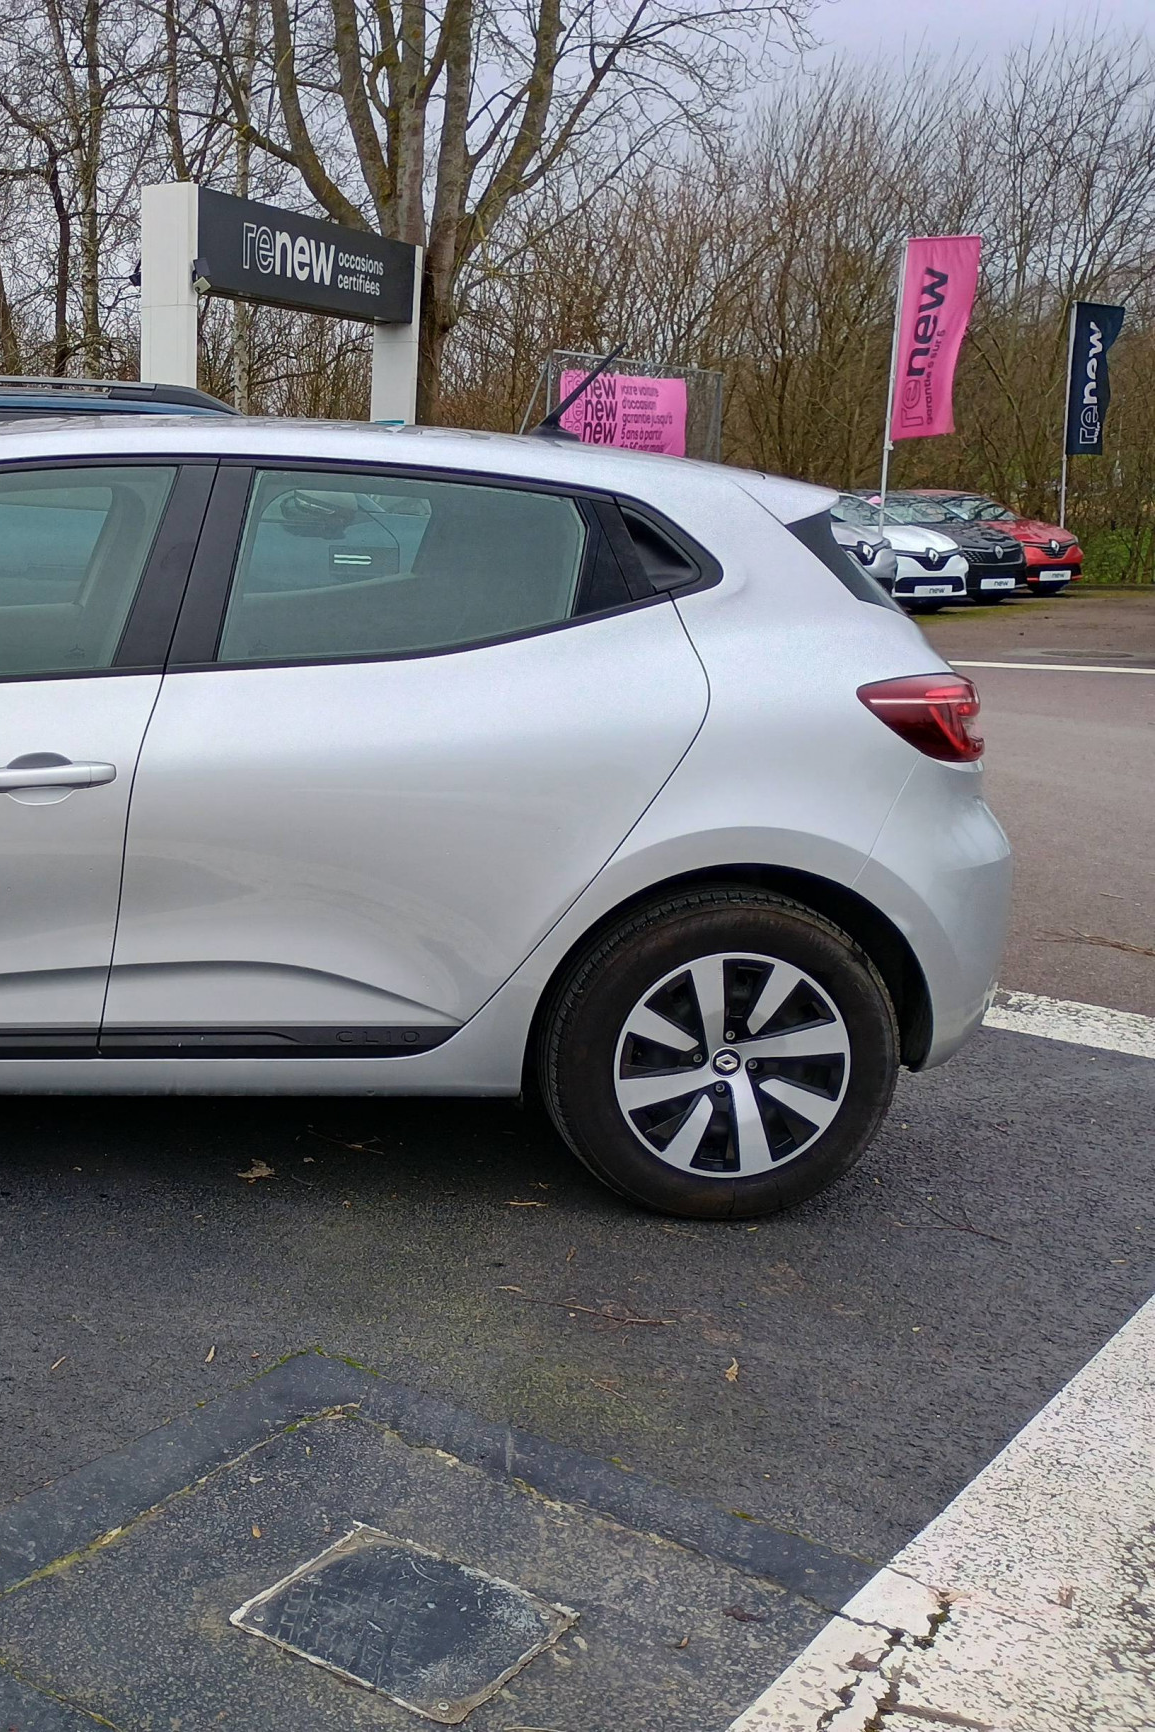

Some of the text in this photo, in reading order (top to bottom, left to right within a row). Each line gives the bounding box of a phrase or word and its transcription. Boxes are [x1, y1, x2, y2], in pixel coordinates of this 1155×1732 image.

[242, 222, 336, 286] renew
[337, 251, 384, 276] occasions
[337, 272, 381, 297] certifiées
[901, 266, 949, 428] renew
[1079, 321, 1103, 444] renew
[622, 411, 650, 427] garantie
[626, 429, 638, 440] ans
[335, 1030, 420, 1044] CLIO
